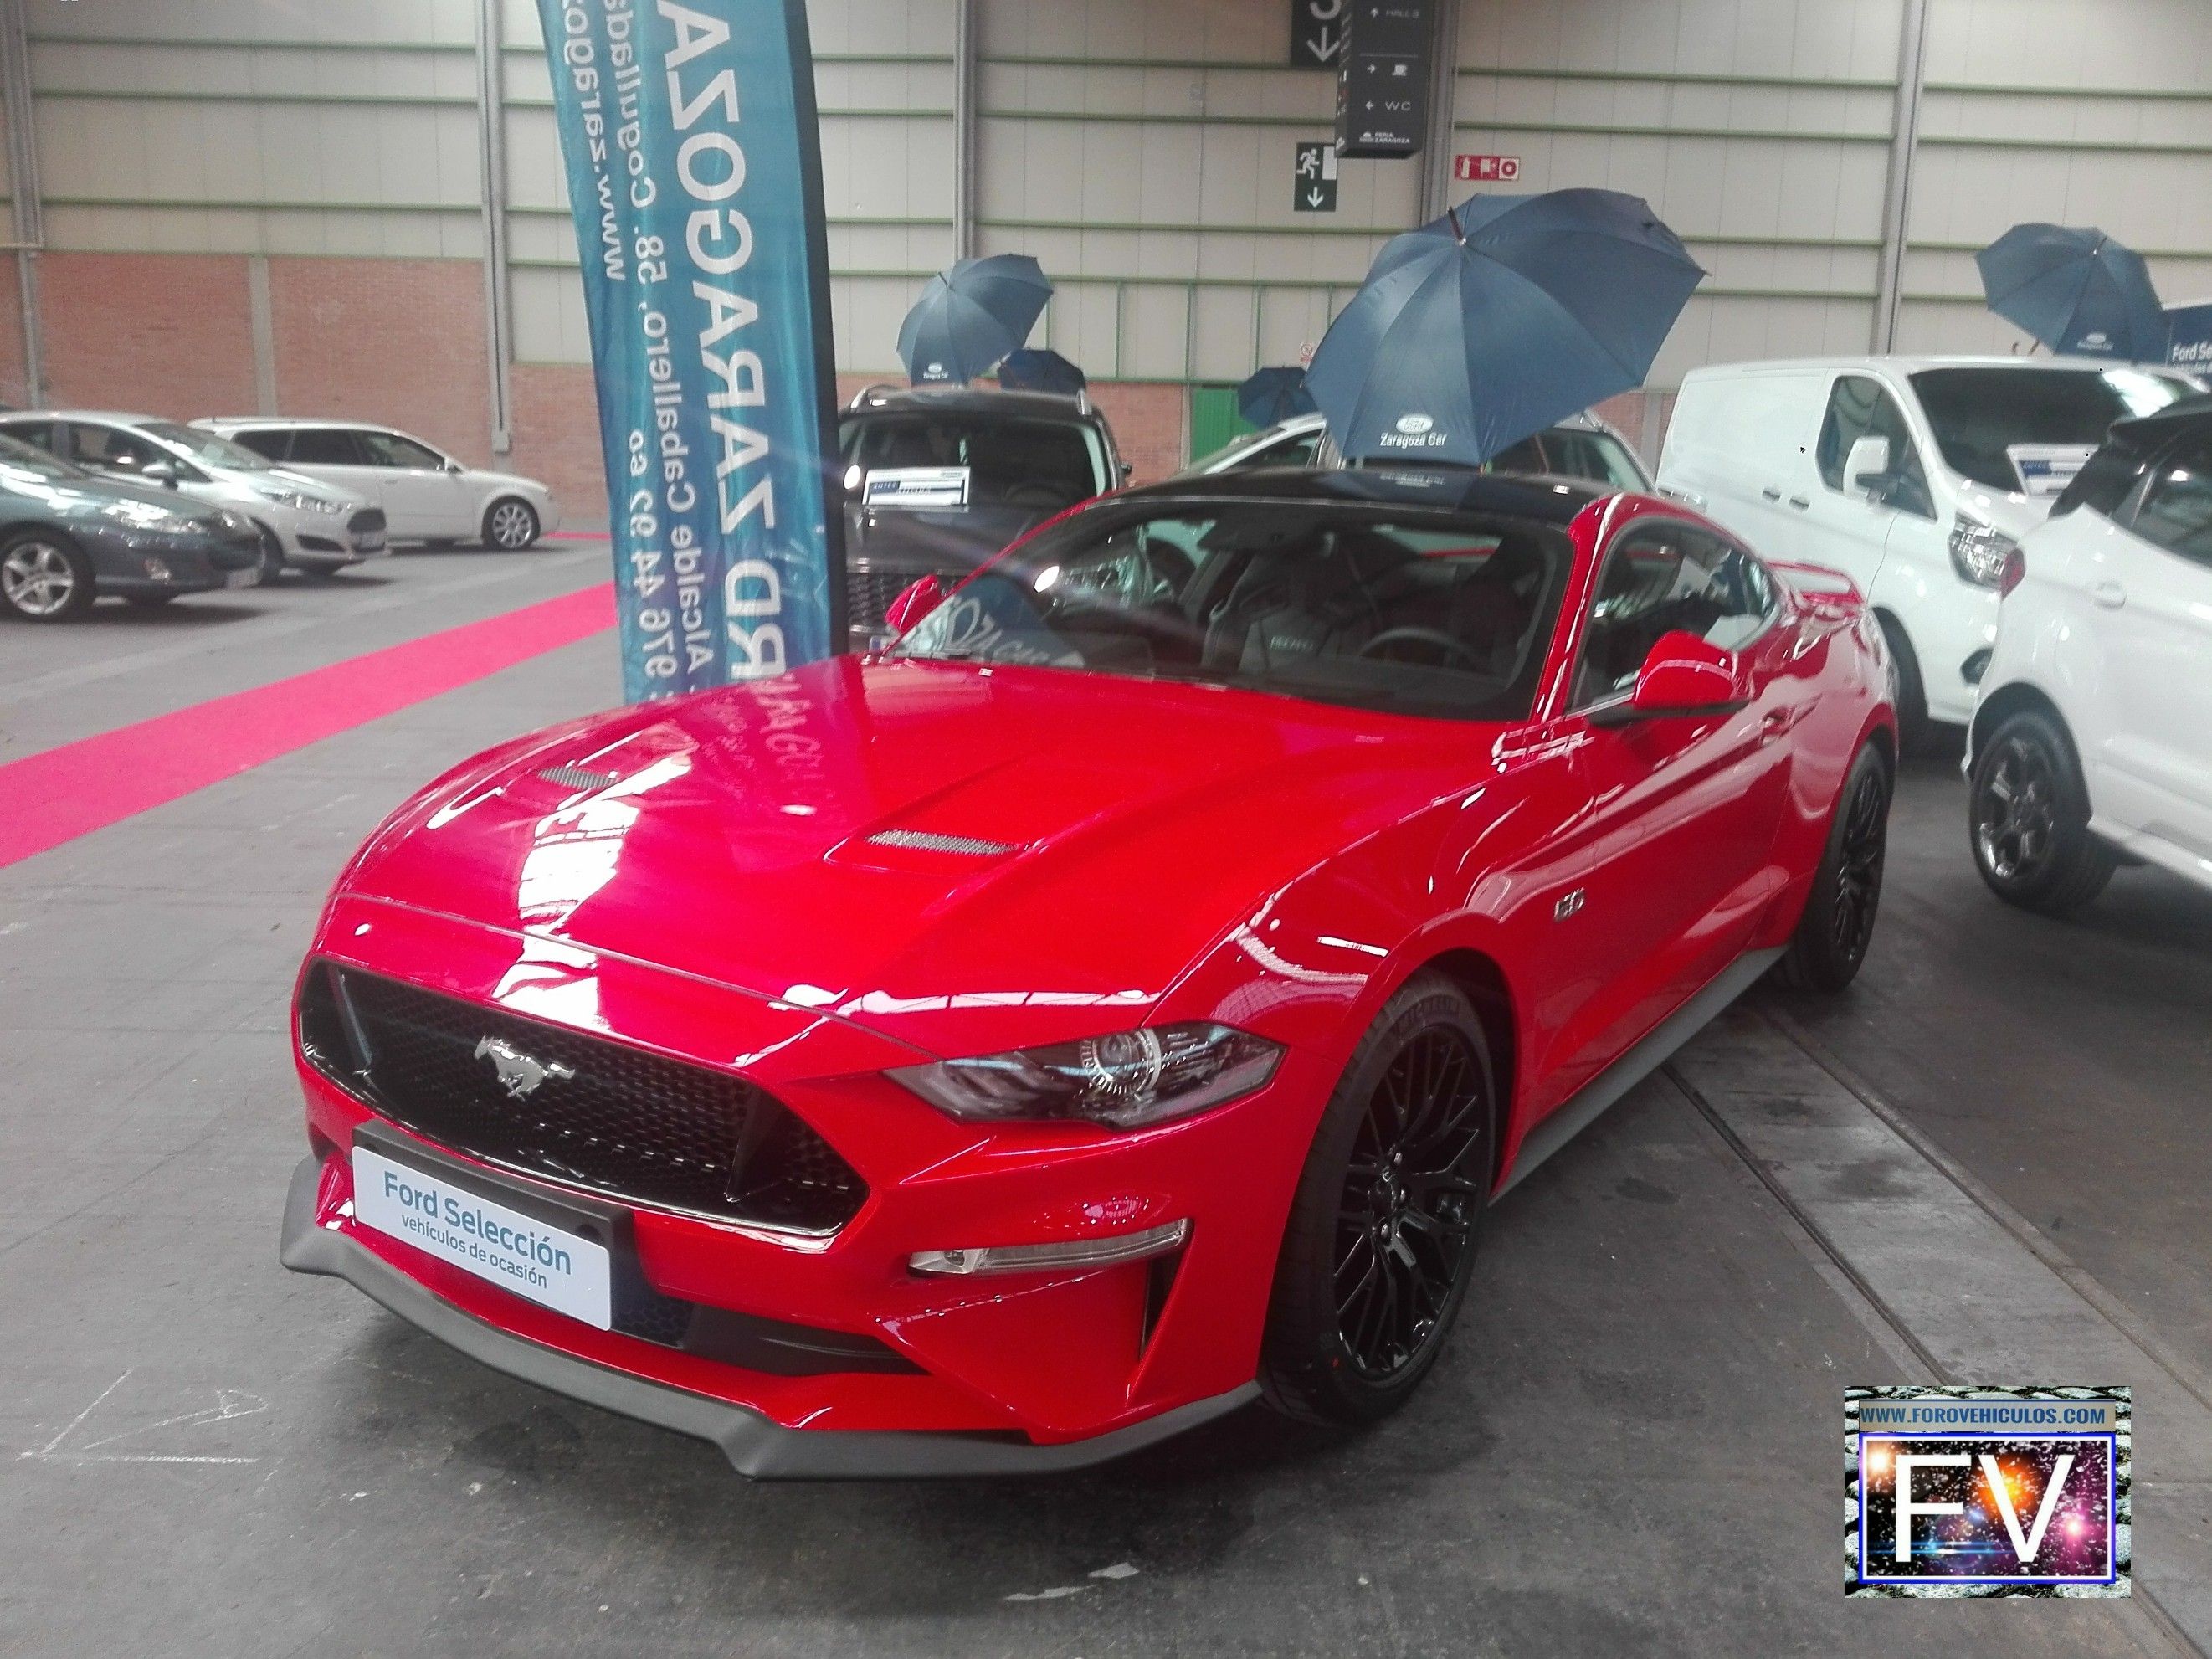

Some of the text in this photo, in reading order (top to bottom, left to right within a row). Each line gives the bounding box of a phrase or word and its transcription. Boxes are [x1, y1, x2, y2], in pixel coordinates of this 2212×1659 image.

[1385, 101, 1411, 110] WC
[2172, 342, 2199, 361] Ford
[1380, 432, 1448, 449] Zaragoza Car
[383, 1170, 572, 1276] Ford Selección
[401, 1214, 548, 1289] vehículos de ocasión
